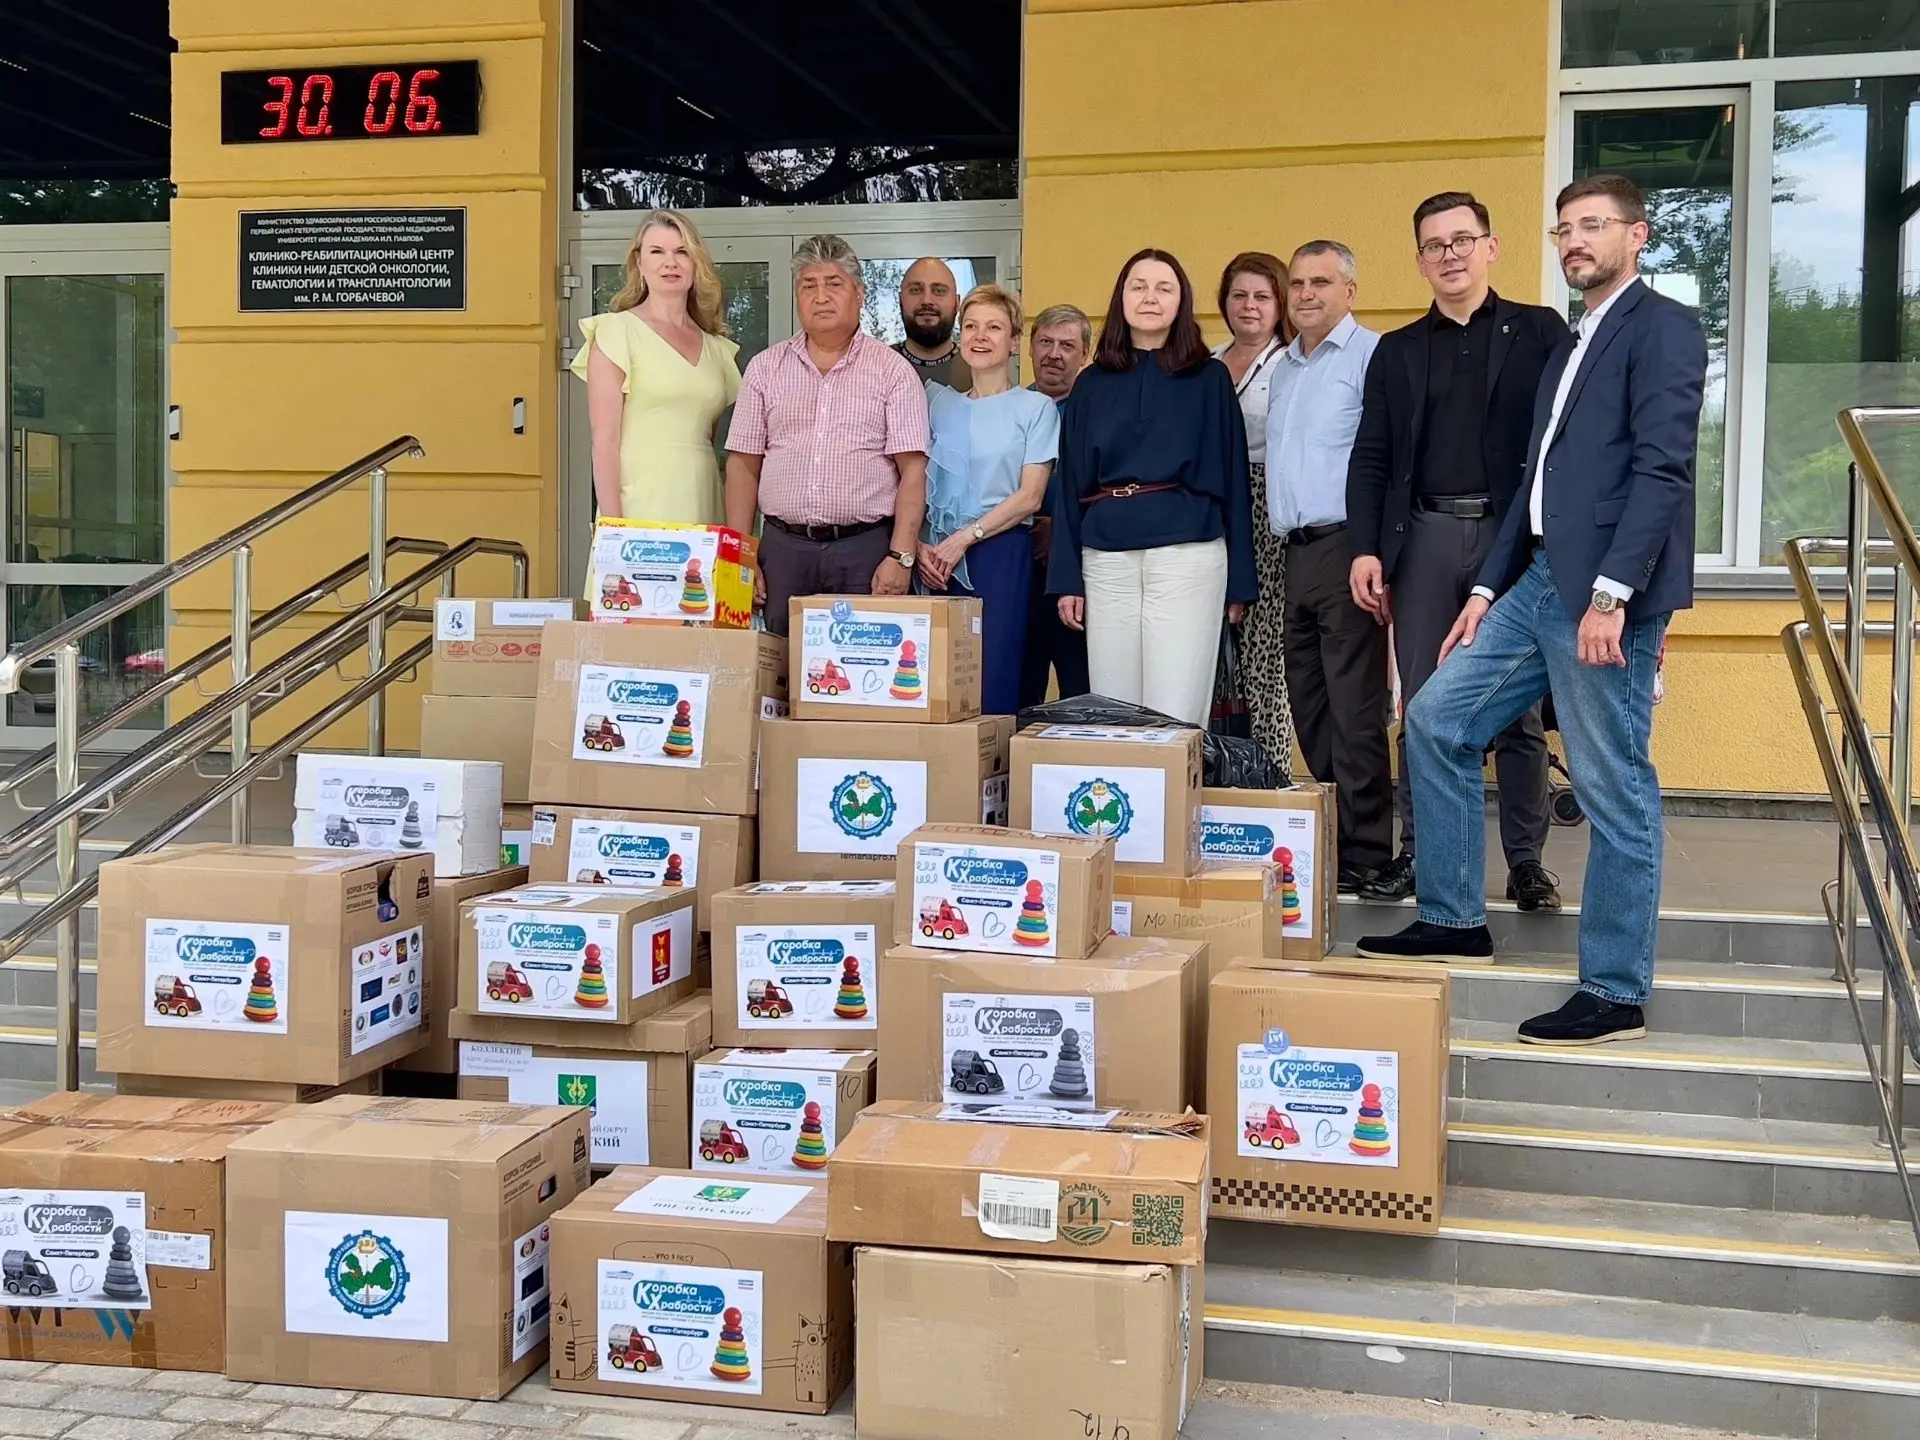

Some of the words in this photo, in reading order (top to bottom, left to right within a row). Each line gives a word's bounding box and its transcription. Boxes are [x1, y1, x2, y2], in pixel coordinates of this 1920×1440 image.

[305, 217, 363, 225] ЗДРАВООХРАНЕНИЯ
[406, 225, 455, 233] МЕДИЦИНСКИЙ
[248, 248, 418, 262] КЛИНИКО-РЕАБИЛИТАЦИОННЫЙ
[420, 249, 455, 260] ЦЕНТР
[253, 264, 302, 275] КЛИНИКИ
[304, 264, 326, 274] НИИ
[328, 262, 377, 276] ДЕТСКОЙ
[379, 264, 450, 274] ОНКОЛОГИИ,
[252, 278, 325, 290] ГЕМАТОЛОГИИ
[327, 279, 335, 288] И
[337, 278, 451, 288] ТРАНСПЛАНТОЛОГИИ
[312, 293, 320, 302] Р.
[322, 292, 334, 302] М.
[336, 290, 405, 302] ГОРБАЧЕВОЙ
[622, 541, 671, 558] Коробка
[831, 623, 881, 640] Коробка
[841, 631, 893, 646] Храбрости
[608, 682, 658, 698] Коробка
[619, 690, 668, 704] Храбрости
[1200, 824, 1245, 837] робка
[600, 836, 650, 853] Коробка
[610, 844, 660, 858] Храбрости
[947, 858, 1003, 878] Коробка
[958, 868, 1016, 885] Храбрости
[510, 925, 563, 944] Коробка
[521, 932, 576, 949] Храбрости
[179, 937, 233, 957] Коробка
[189, 946, 245, 963] Храбрости
[769, 941, 822, 960] Коробка
[780, 950, 834, 965] Храбрости
[978, 1010, 1037, 1030] Коробка
[990, 1019, 1051, 1035] Храбрости
[1273, 1062, 1336, 1083] Коробка
[1286, 1072, 1350, 1090] Храбрости
[726, 1080, 782, 1101] Коробка
[837, 1076, 862, 1104] 10
[738, 1090, 794, 1108] Храбрости
[28, 1206, 87, 1228] Коробка
[40, 1216, 102, 1234] Храбрости
[636, 1282, 698, 1304] Коробка
[648, 1292, 712, 1313] Храбрости
